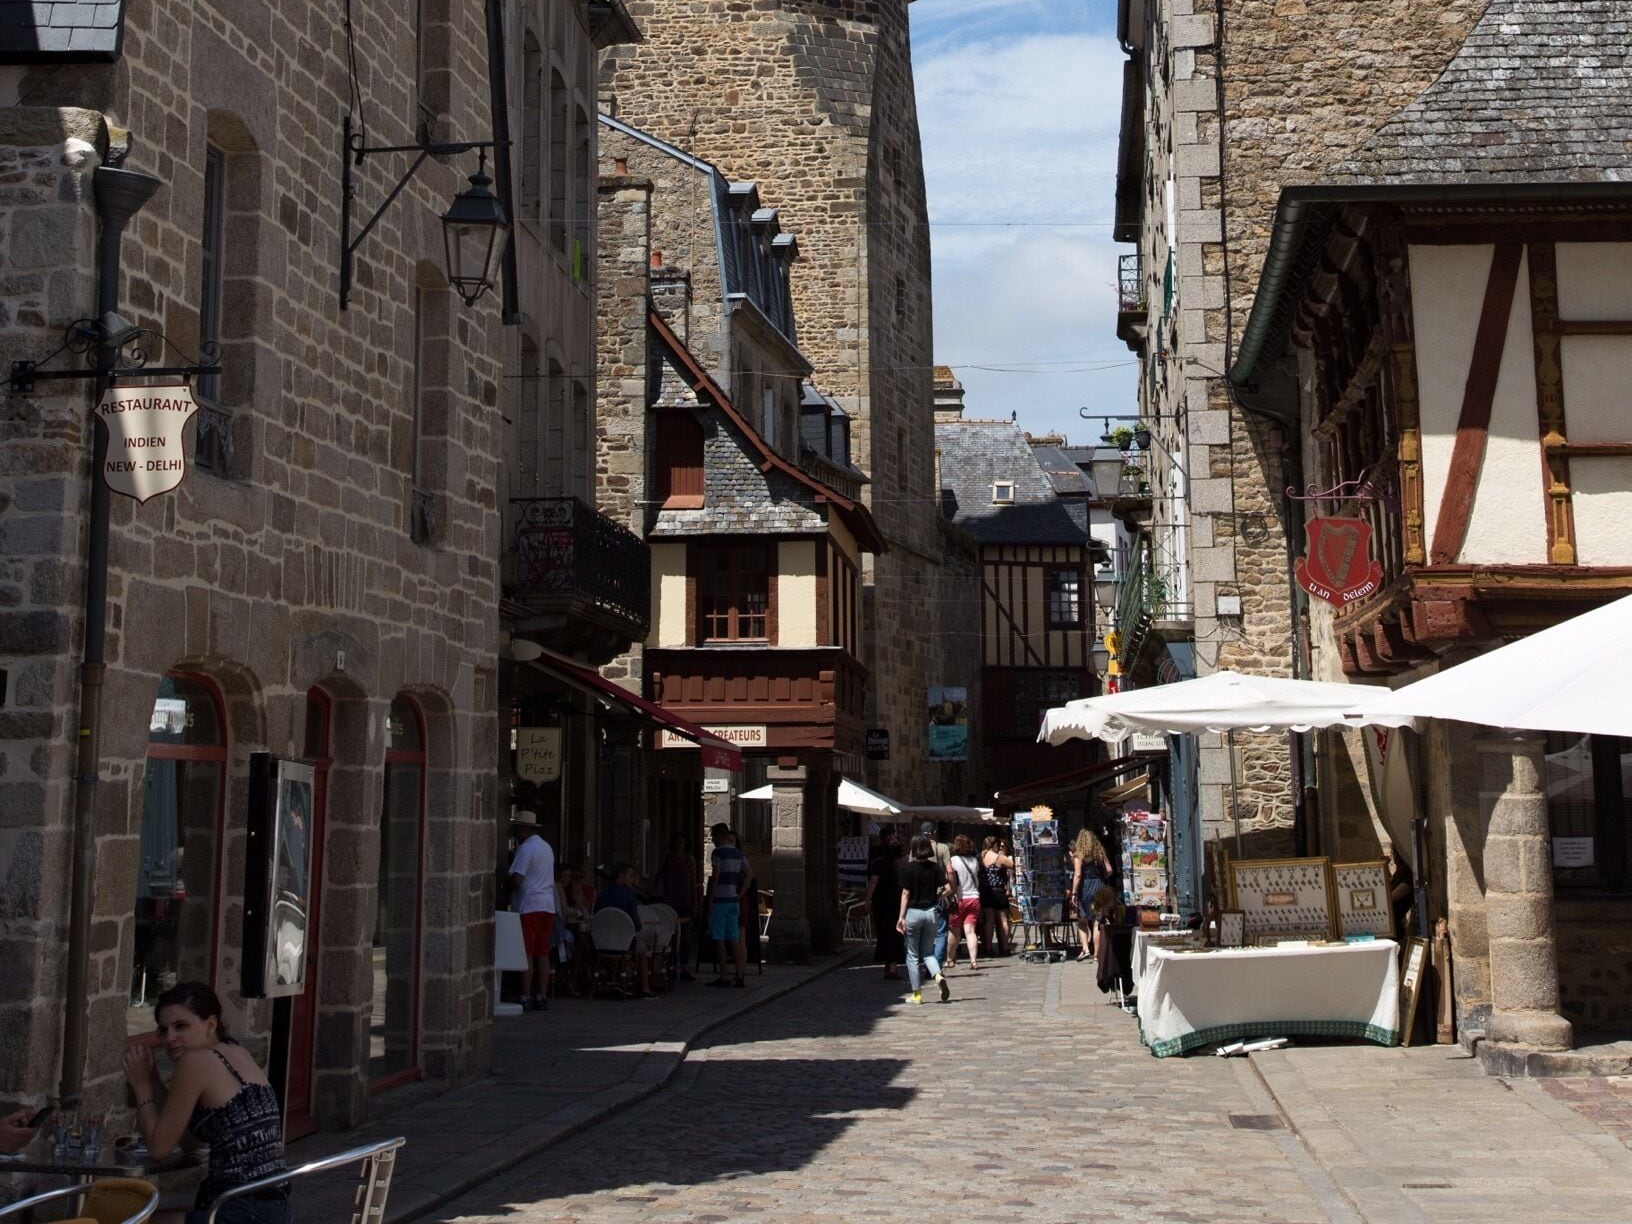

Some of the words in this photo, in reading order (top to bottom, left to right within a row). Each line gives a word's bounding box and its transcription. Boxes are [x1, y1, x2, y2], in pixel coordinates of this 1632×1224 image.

[101, 397, 192, 416] RESTAURANT
[124, 436, 166, 449] INDIEN
[107, 460, 137, 473] NEW
[147, 458, 182, 472] DELHI
[531, 733, 548, 744] La
[521, 748, 557, 761] P'tite
[525, 763, 554, 775] Pizz
